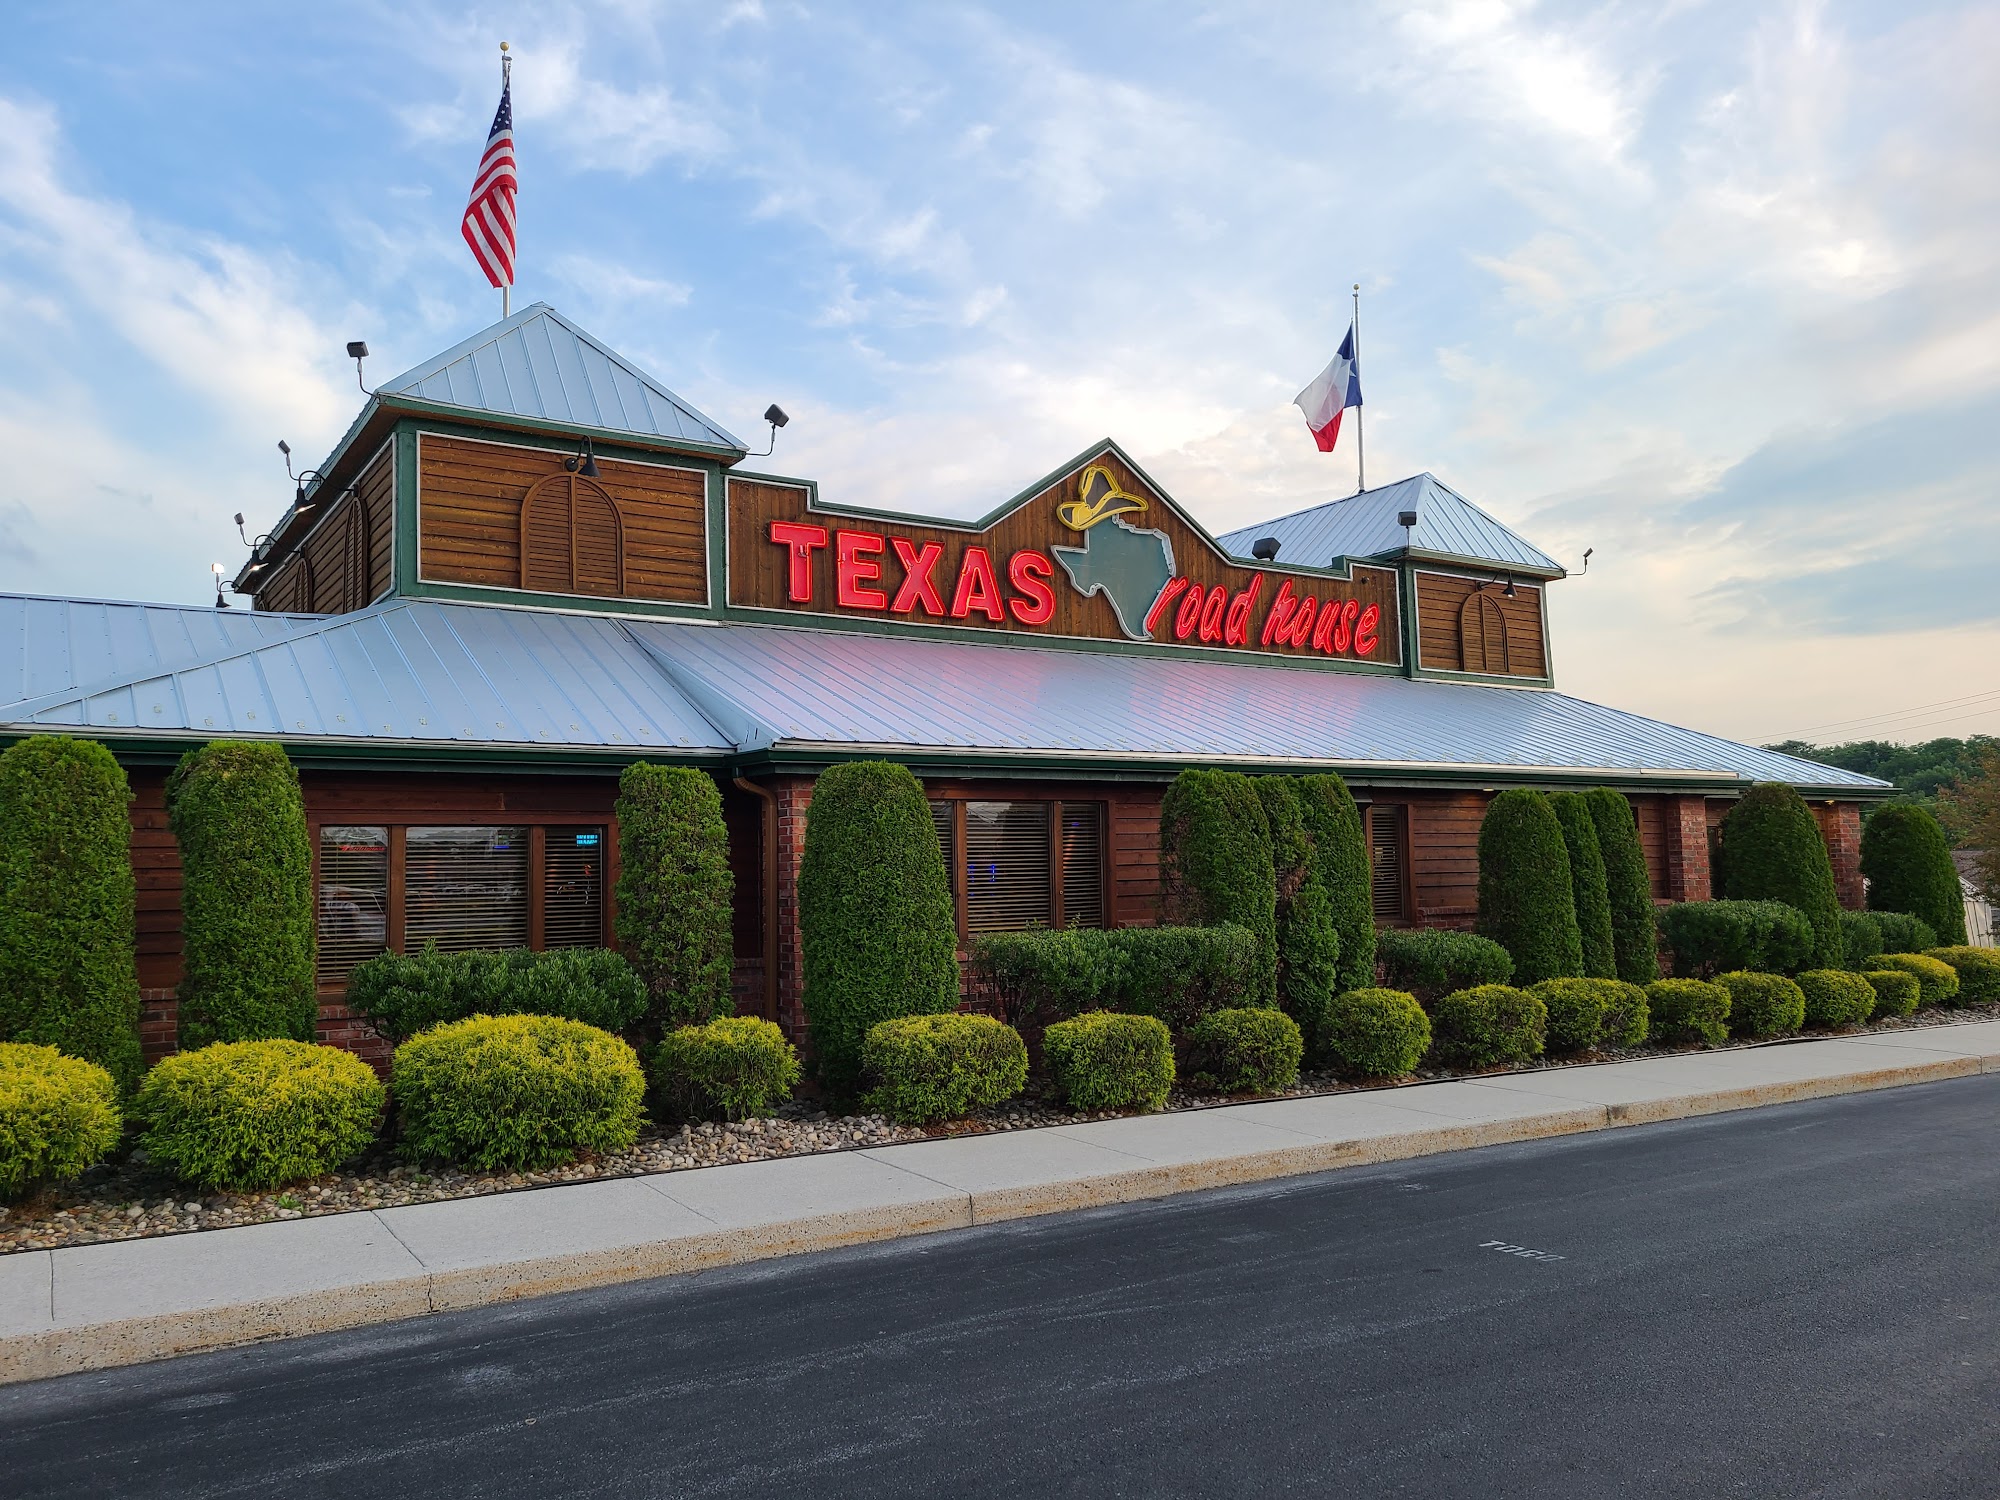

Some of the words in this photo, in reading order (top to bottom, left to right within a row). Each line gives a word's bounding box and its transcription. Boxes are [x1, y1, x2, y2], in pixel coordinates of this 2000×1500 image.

[769, 520, 1056, 625] TEXAS
[1147, 573, 1264, 645] road
[1264, 578, 1381, 656] house
